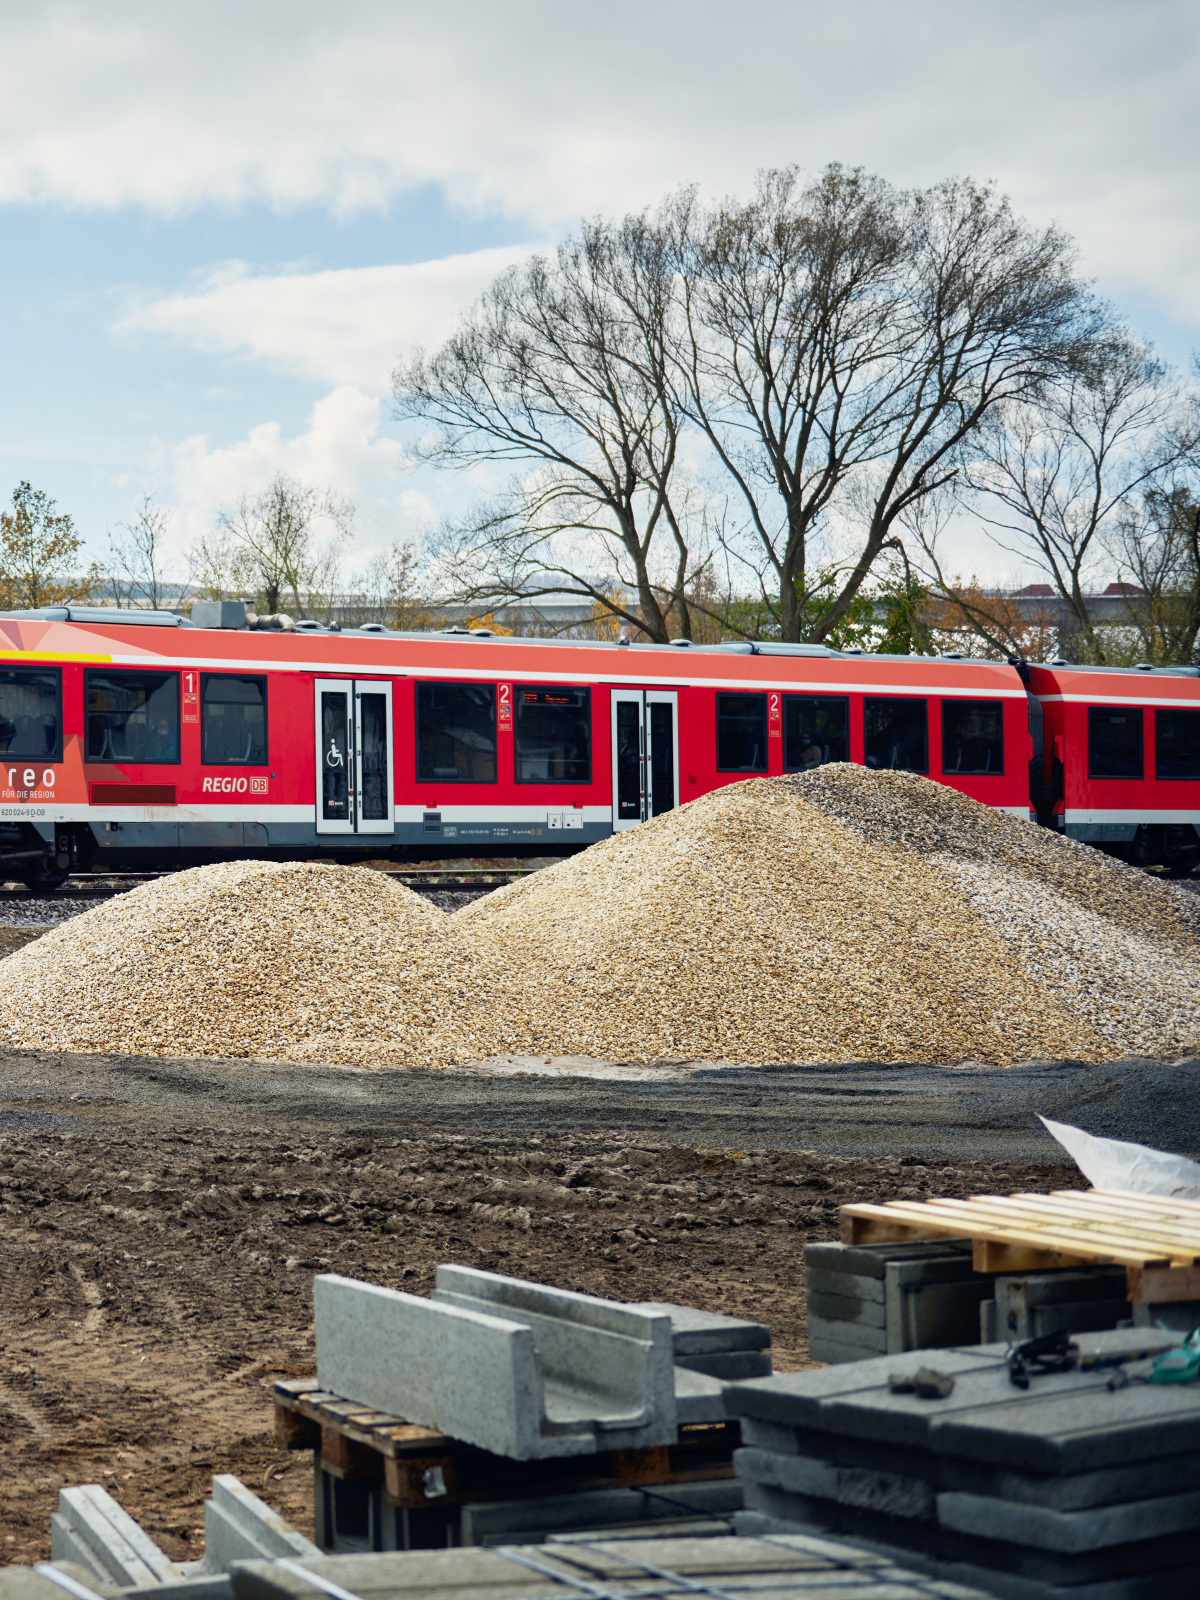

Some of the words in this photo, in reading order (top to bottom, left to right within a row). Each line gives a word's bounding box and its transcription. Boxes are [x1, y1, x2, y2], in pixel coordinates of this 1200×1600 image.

[185, 672, 193, 693] 1
[500, 684, 509, 704] 2
[770, 694, 779, 712] 2
[2, 788, 15, 798] FÜR
[16, 790, 28, 798] DIE
[29, 790, 55, 799] REGION
[202, 777, 248, 793] REGIO
[251, 778, 267, 792] DB
